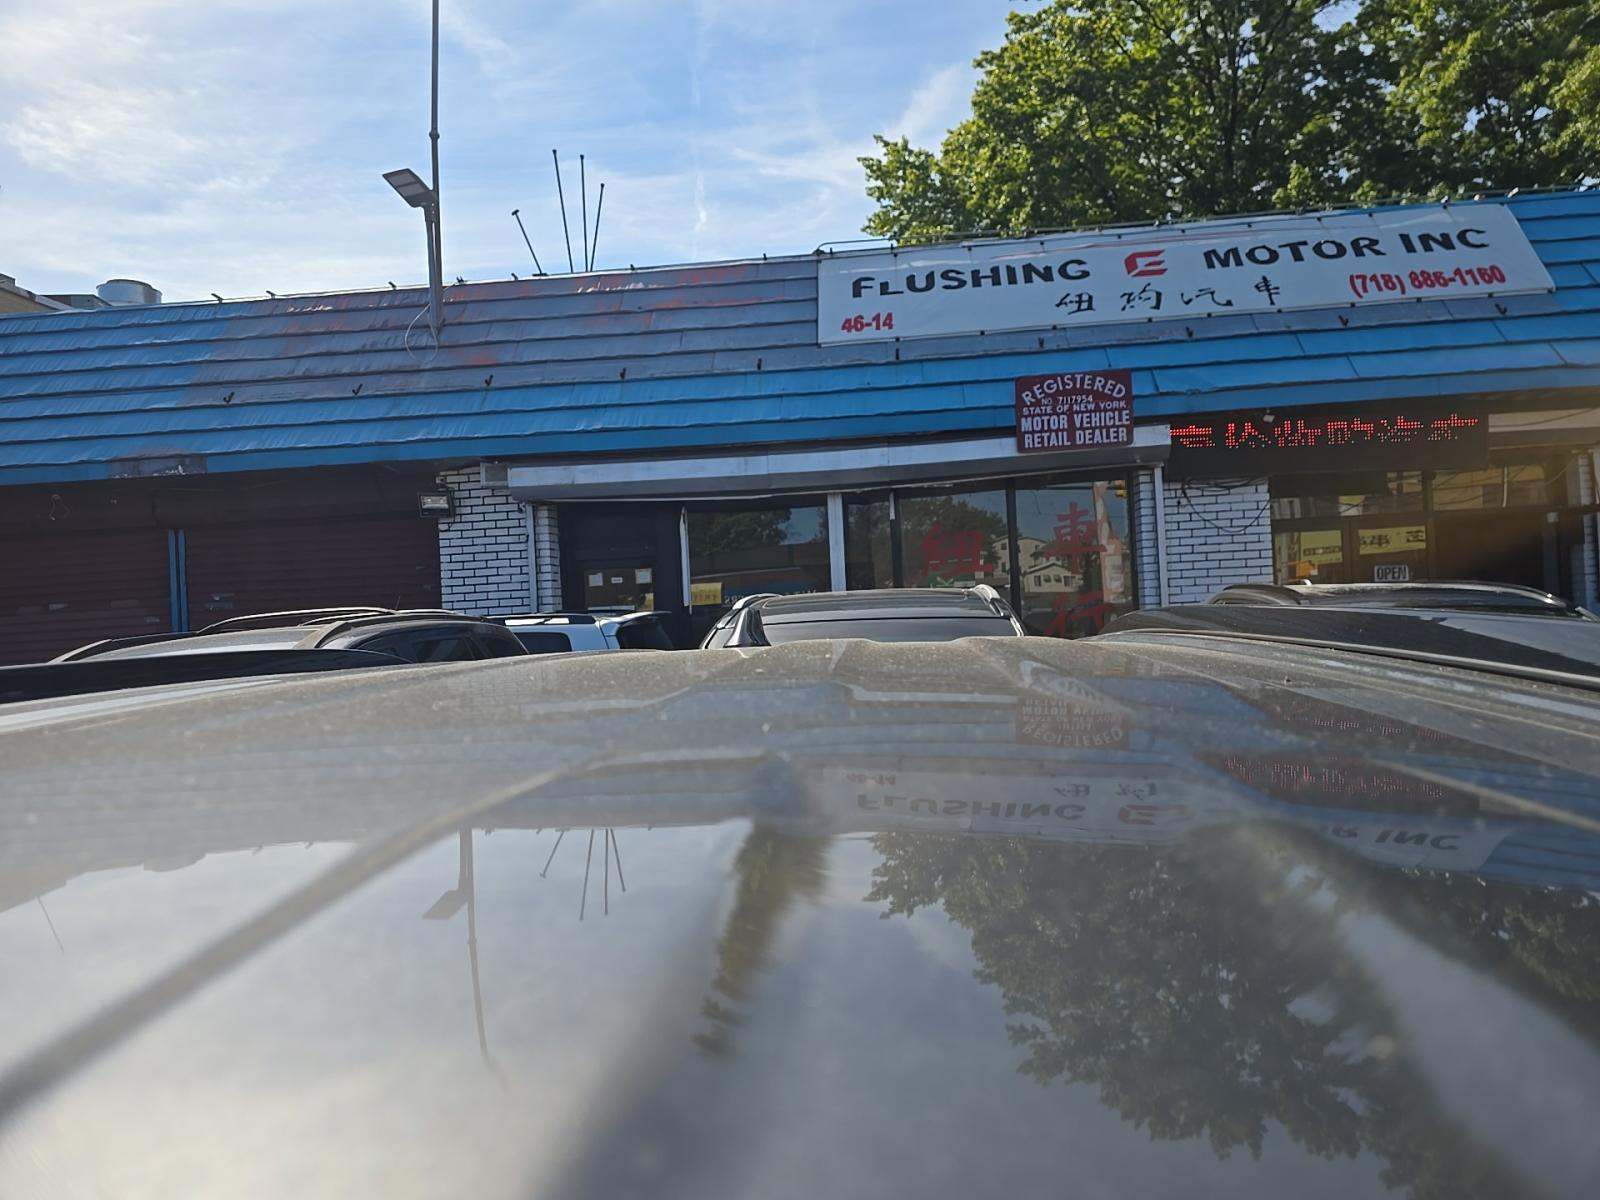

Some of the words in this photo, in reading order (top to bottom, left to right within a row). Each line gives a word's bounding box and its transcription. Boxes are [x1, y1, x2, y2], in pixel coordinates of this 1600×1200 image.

[852, 259, 1090, 298] FLUSHING
[1203, 237, 1386, 269] MOTOR
[1399, 228, 1490, 254] INC
[1349, 273, 1406, 299] (718)
[1410, 264, 1507, 291] 886-1160
[841, 312, 894, 333] 46-14
[1022, 374, 1125, 405] REGISTERED
[1022, 406, 1052, 416] STATE
[1056, 405, 1069, 413] OF
[1073, 402, 1095, 412] NEW
[1099, 400, 1126, 409] YORK
[1021, 414, 1068, 432] MOTOR
[1074, 410, 1130, 428] VEHICLE
[1024, 431, 1071, 449] RETAIL
[1076, 427, 1128, 446] DEALER
[1376, 566, 1408, 580] OPEN
